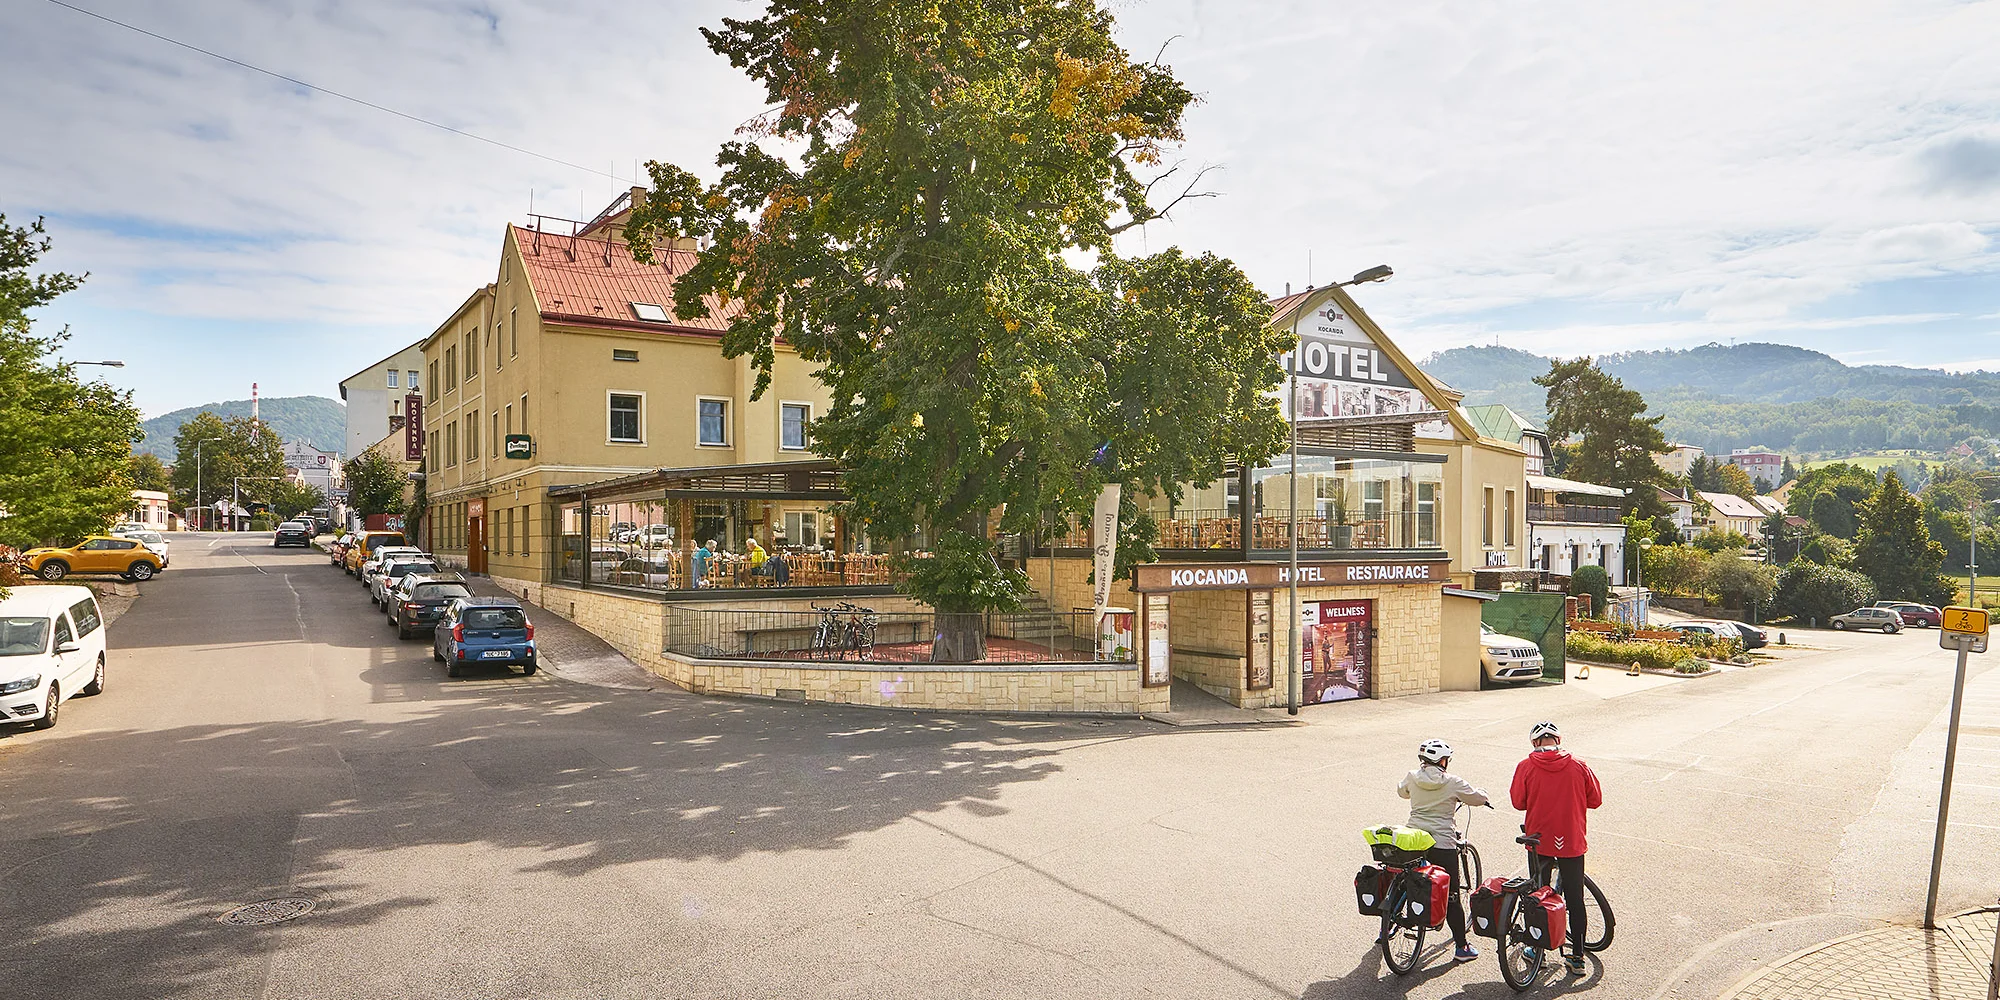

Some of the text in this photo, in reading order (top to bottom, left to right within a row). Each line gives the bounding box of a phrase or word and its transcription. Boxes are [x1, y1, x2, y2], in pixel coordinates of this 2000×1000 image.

[1317, 326, 1344, 335] KOCANDA
[1488, 551, 1509, 566] HOTEL
[1171, 568, 1249, 586] KOCANDA
[1346, 565, 1429, 581] RESTAURACE
[1326, 606, 1366, 618] WELLNESS
[1961, 611, 1969, 621] 2
